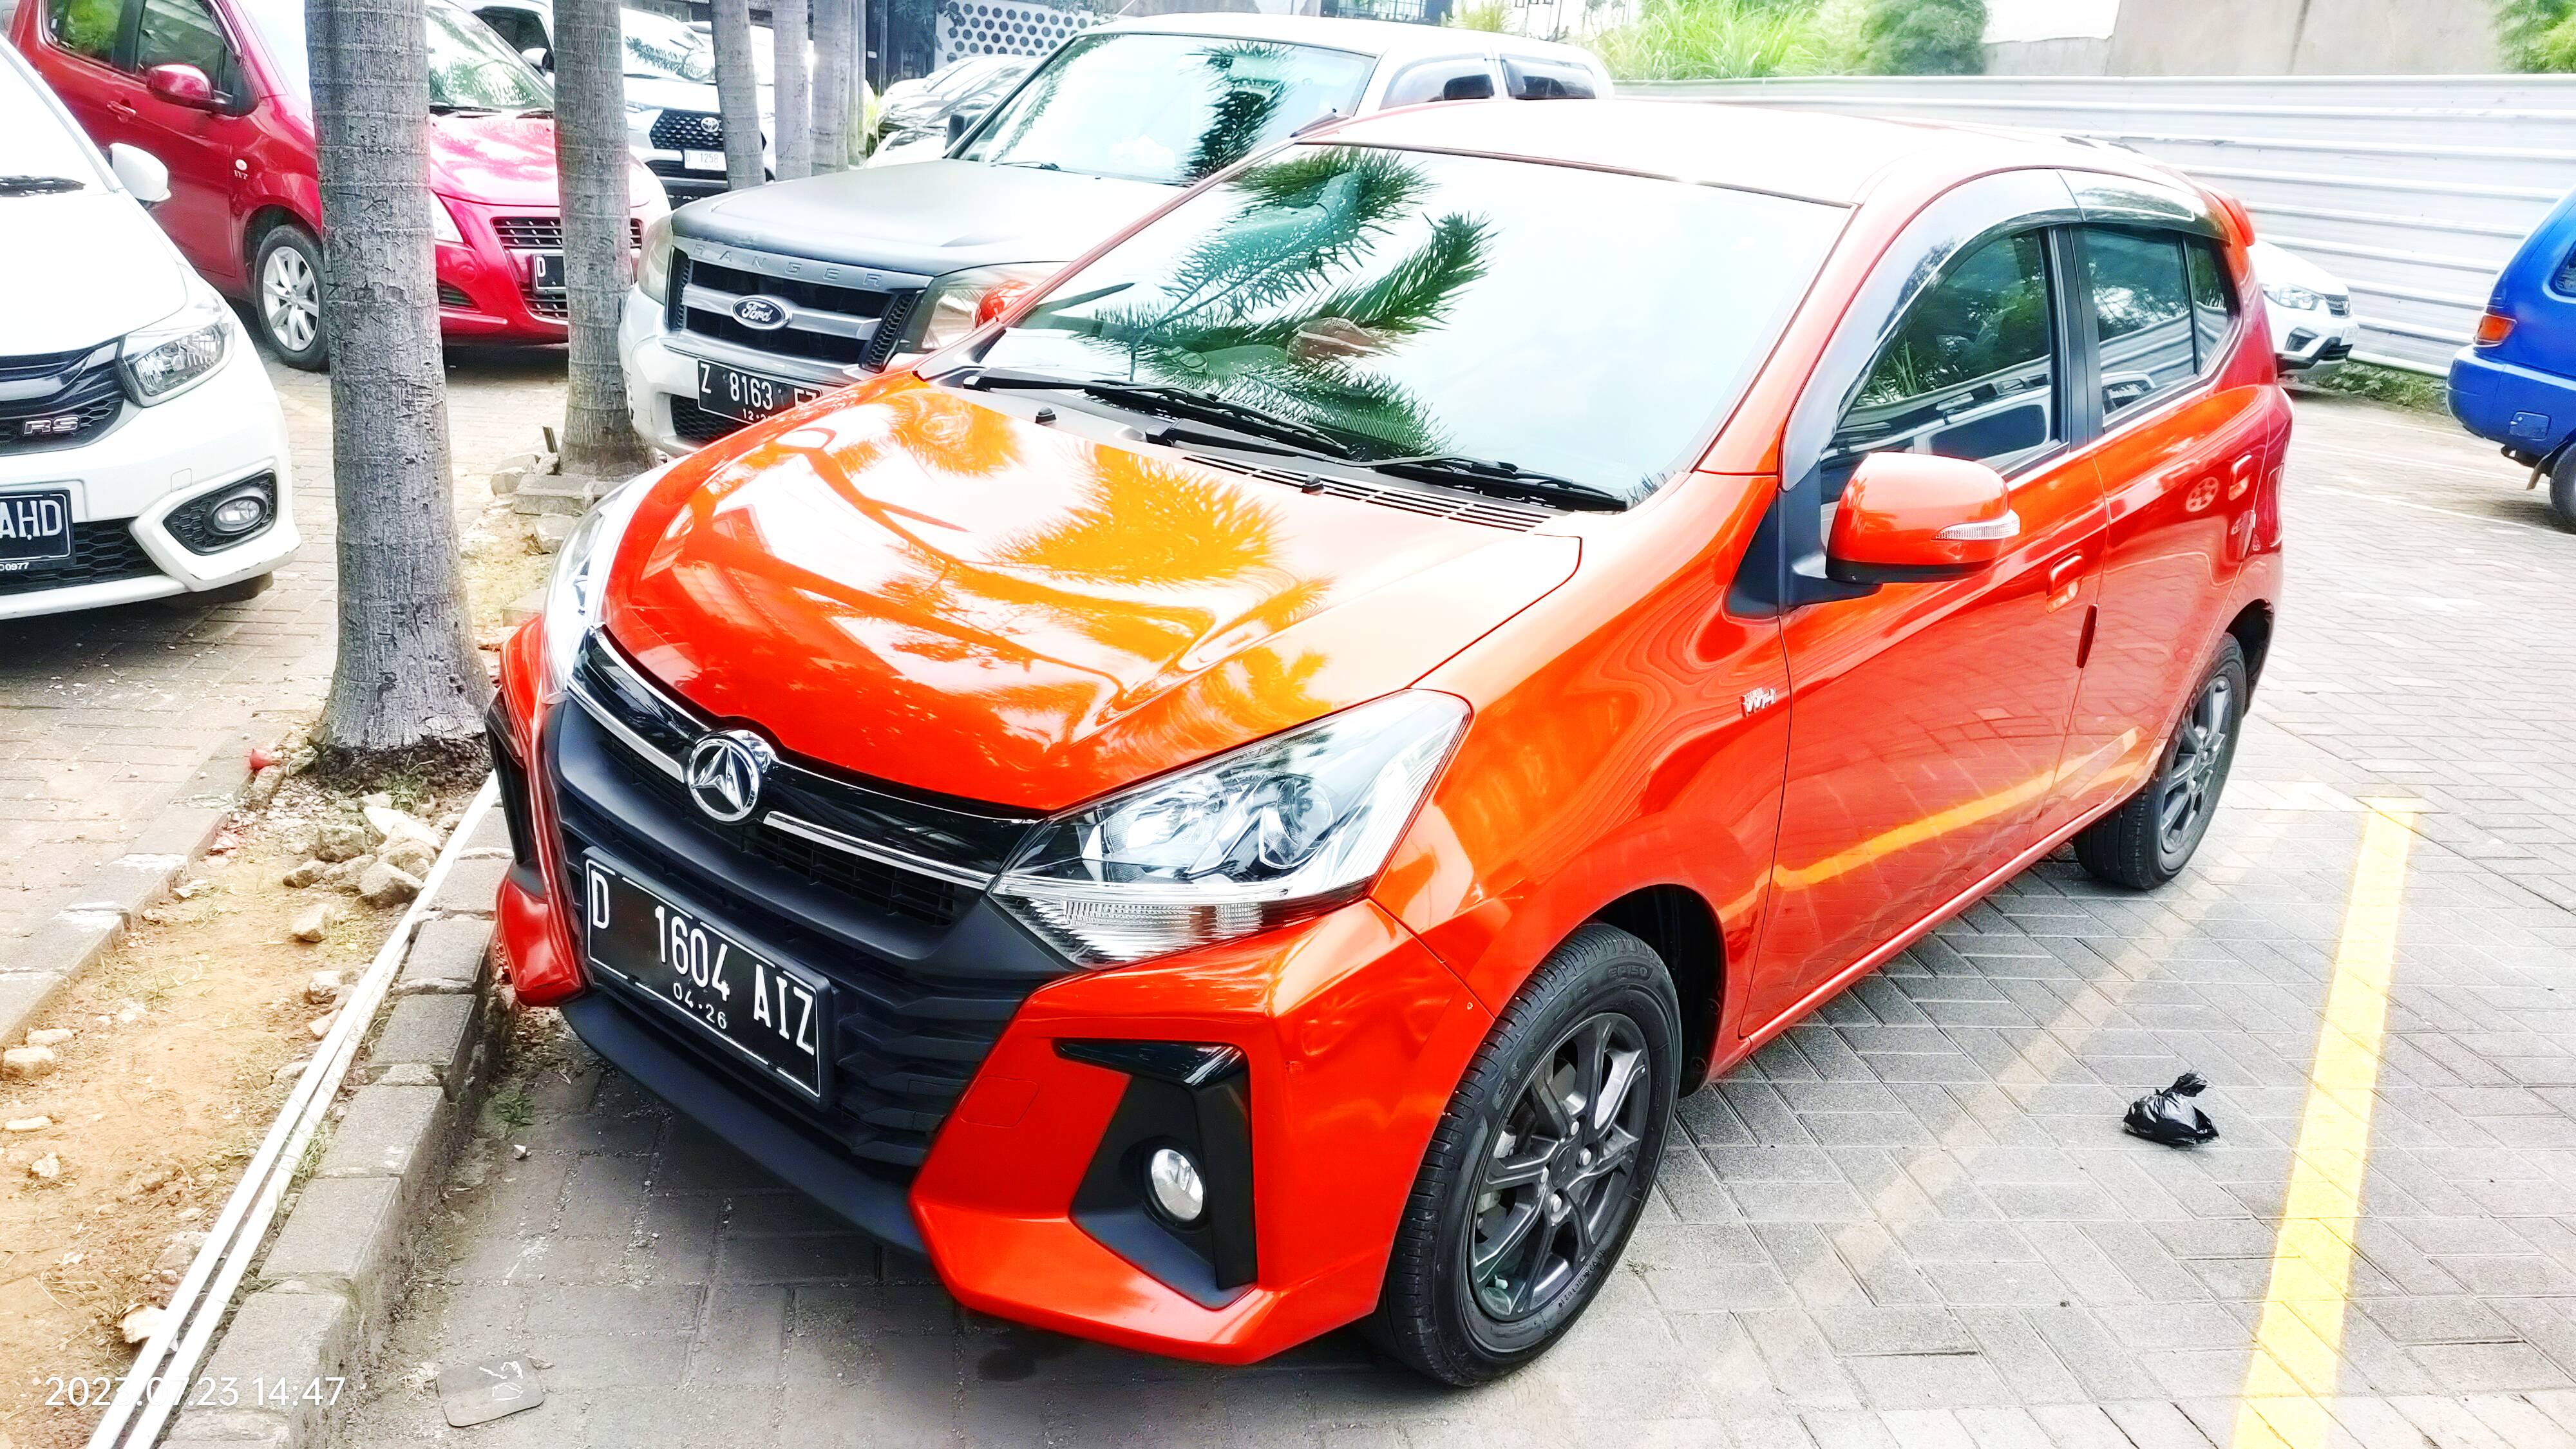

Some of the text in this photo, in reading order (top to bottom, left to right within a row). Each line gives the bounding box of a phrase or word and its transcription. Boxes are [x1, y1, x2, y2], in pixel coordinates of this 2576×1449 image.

[536, 256, 546, 277] D
[693, 243, 882, 287] RANGER
[741, 300, 773, 323] Ford
[701, 363, 711, 393] Z
[730, 372, 773, 410] 8163
[23, 415, 79, 435] RS
[0, 500, 62, 538] AHD
[591, 869, 815, 1056] D 1604 AIZ
